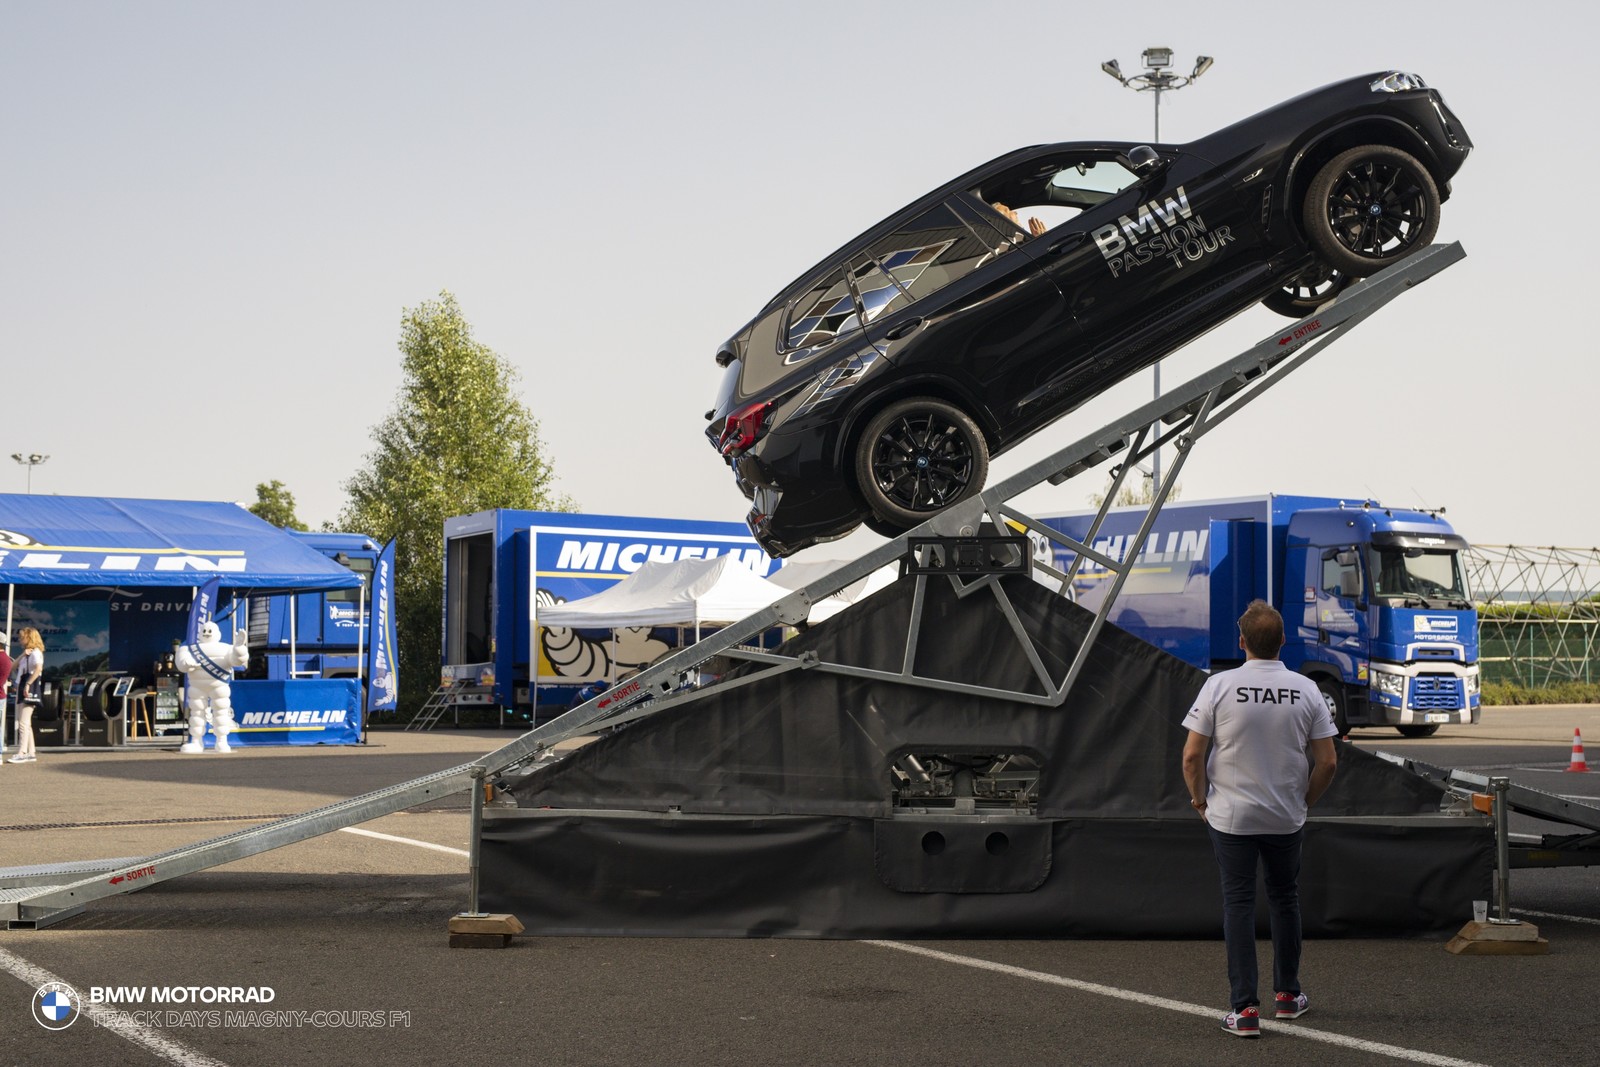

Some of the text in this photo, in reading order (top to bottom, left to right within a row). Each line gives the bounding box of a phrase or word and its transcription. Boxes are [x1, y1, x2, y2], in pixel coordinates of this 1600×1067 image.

[1091, 186, 1193, 260] BMW
[1107, 214, 1207, 279] PASSION
[1166, 225, 1236, 269] TOUR
[1293, 319, 1322, 340] ENTREE
[0, 550, 248, 572] LIN
[111, 602, 191, 612] ST DRIVI
[612, 681, 641, 703] SORTIE
[1236, 687, 1301, 705] STAFF
[241, 710, 347, 725] MICHELIN
[126, 865, 156, 882] SORTIE
